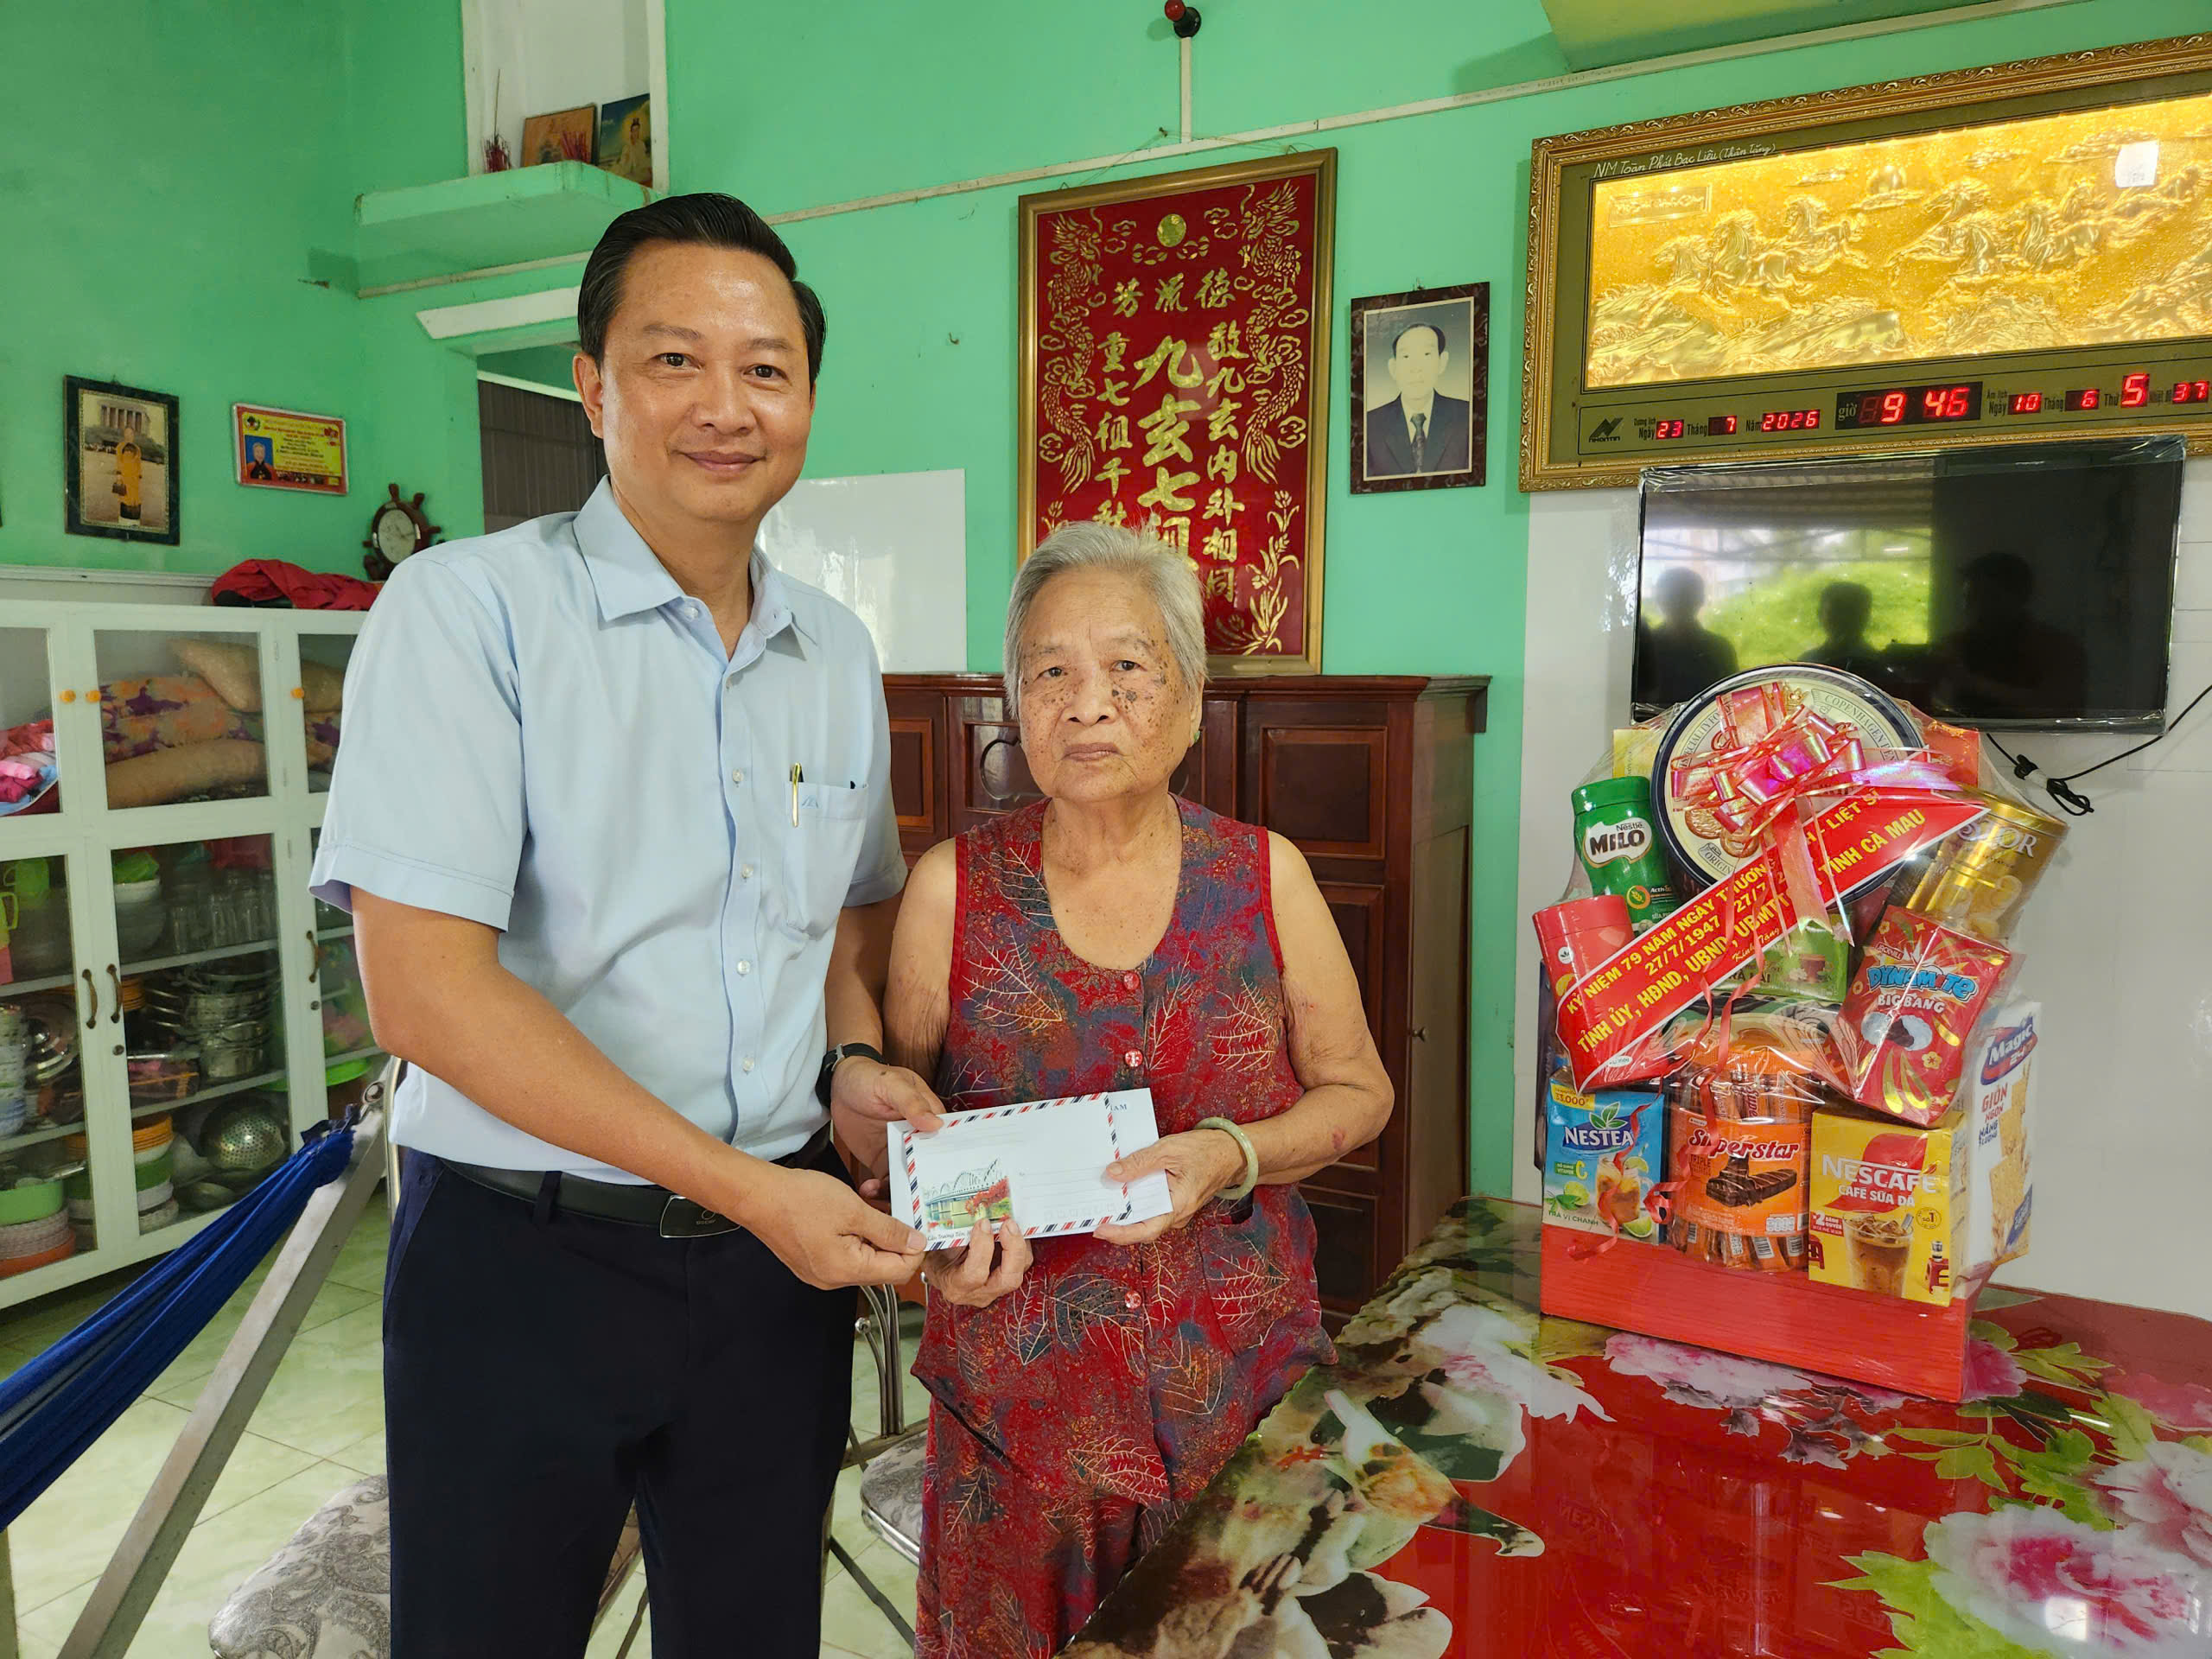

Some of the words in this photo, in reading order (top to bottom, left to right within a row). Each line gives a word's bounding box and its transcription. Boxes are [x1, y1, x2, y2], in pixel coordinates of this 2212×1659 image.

[1593, 161, 1618, 178] NM
[1621, 161, 1647, 175] Toàn
[1649, 155, 1672, 170] Phát
[1697, 149, 1718, 162] Liêu
[1838, 404, 1857, 421] giờ
[1881, 391, 1906, 423] 9
[1923, 387, 1969, 417] 46
[2013, 394, 2041, 411] 10
[2044, 397, 2063, 413] Tháng
[2081, 390, 2097, 408] 6
[2122, 373, 2148, 407] 5
[2173, 381, 2208, 403] 37
[1656, 422, 1683, 439] 23
[1688, 423, 1707, 437] Tháng
[1726, 416, 1737, 433] 7
[1763, 410, 1819, 430] 2026
[1824, 694, 1885, 742] COPENHAGEN
[1590, 830, 1645, 855] MILO
[1567, 992, 1584, 1014] KỶ
[1584, 966, 1623, 1000] NIỆM
[1621, 951, 1643, 972] 79
[1642, 926, 1677, 957] NĂM
[1676, 899, 1715, 931] NGÀY
[1826, 801, 1860, 830] LIỆT
[1577, 1020, 1613, 1053] TỈNH
[1607, 1002, 1642, 1028] ỦY,
[1637, 970, 1689, 1008] HĐND,
[1860, 830, 1889, 855] CÀ
[1884, 809, 1925, 840] MAU
[1878, 995, 1901, 1007] BIG
[1903, 995, 1945, 1014] BANG
[1989, 1023, 2032, 1065] Magic
[1565, 1126, 1634, 1147] NESTEA
[1575, 1160, 1588, 1180] C
[1822, 1154, 1939, 1193] NESCAFÉ
[1870, 1190, 1894, 1205] SỮA
[1573, 1216, 1599, 1226] CHANH
